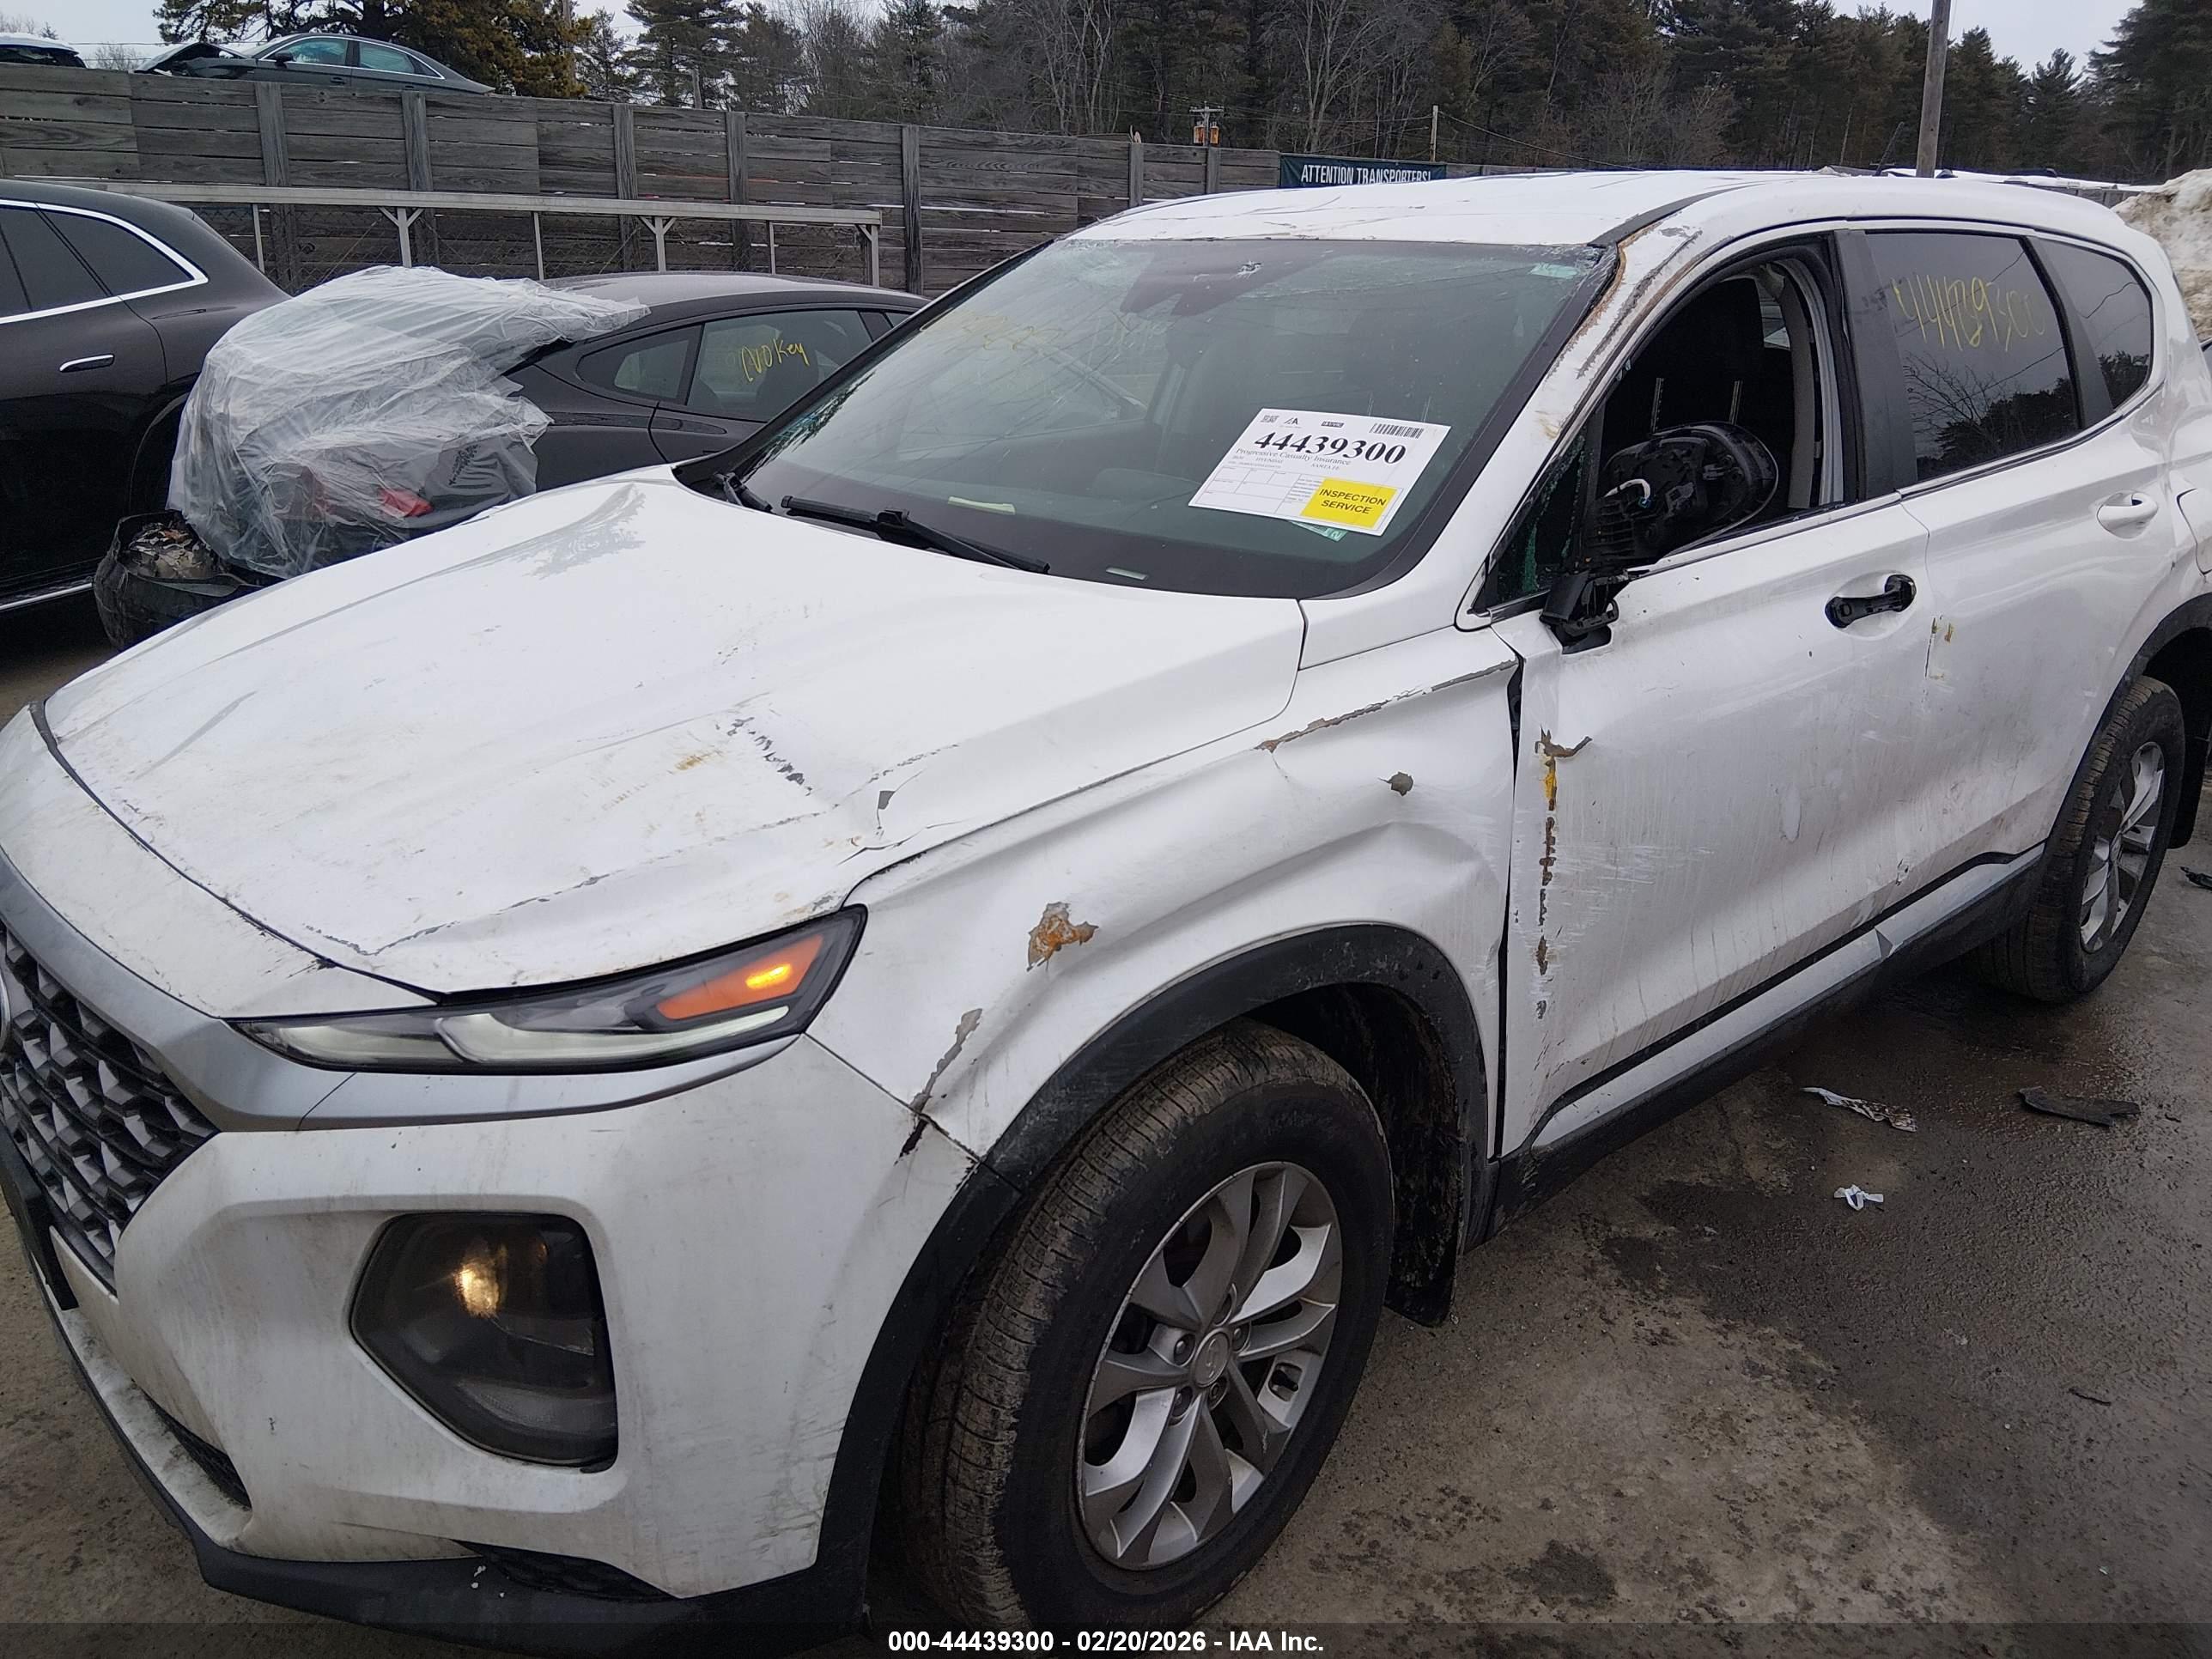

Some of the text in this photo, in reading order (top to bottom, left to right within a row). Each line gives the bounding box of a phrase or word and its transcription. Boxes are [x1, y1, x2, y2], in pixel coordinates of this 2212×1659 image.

[1301, 164, 1353, 185] ATTENTION
[1237, 447, 1352, 465] Progressive Casualty Insurance
[1254, 431, 1407, 465] 44439300
[1319, 489, 1387, 507] INSPECTION
[1321, 500, 1372, 514] SERVICE
